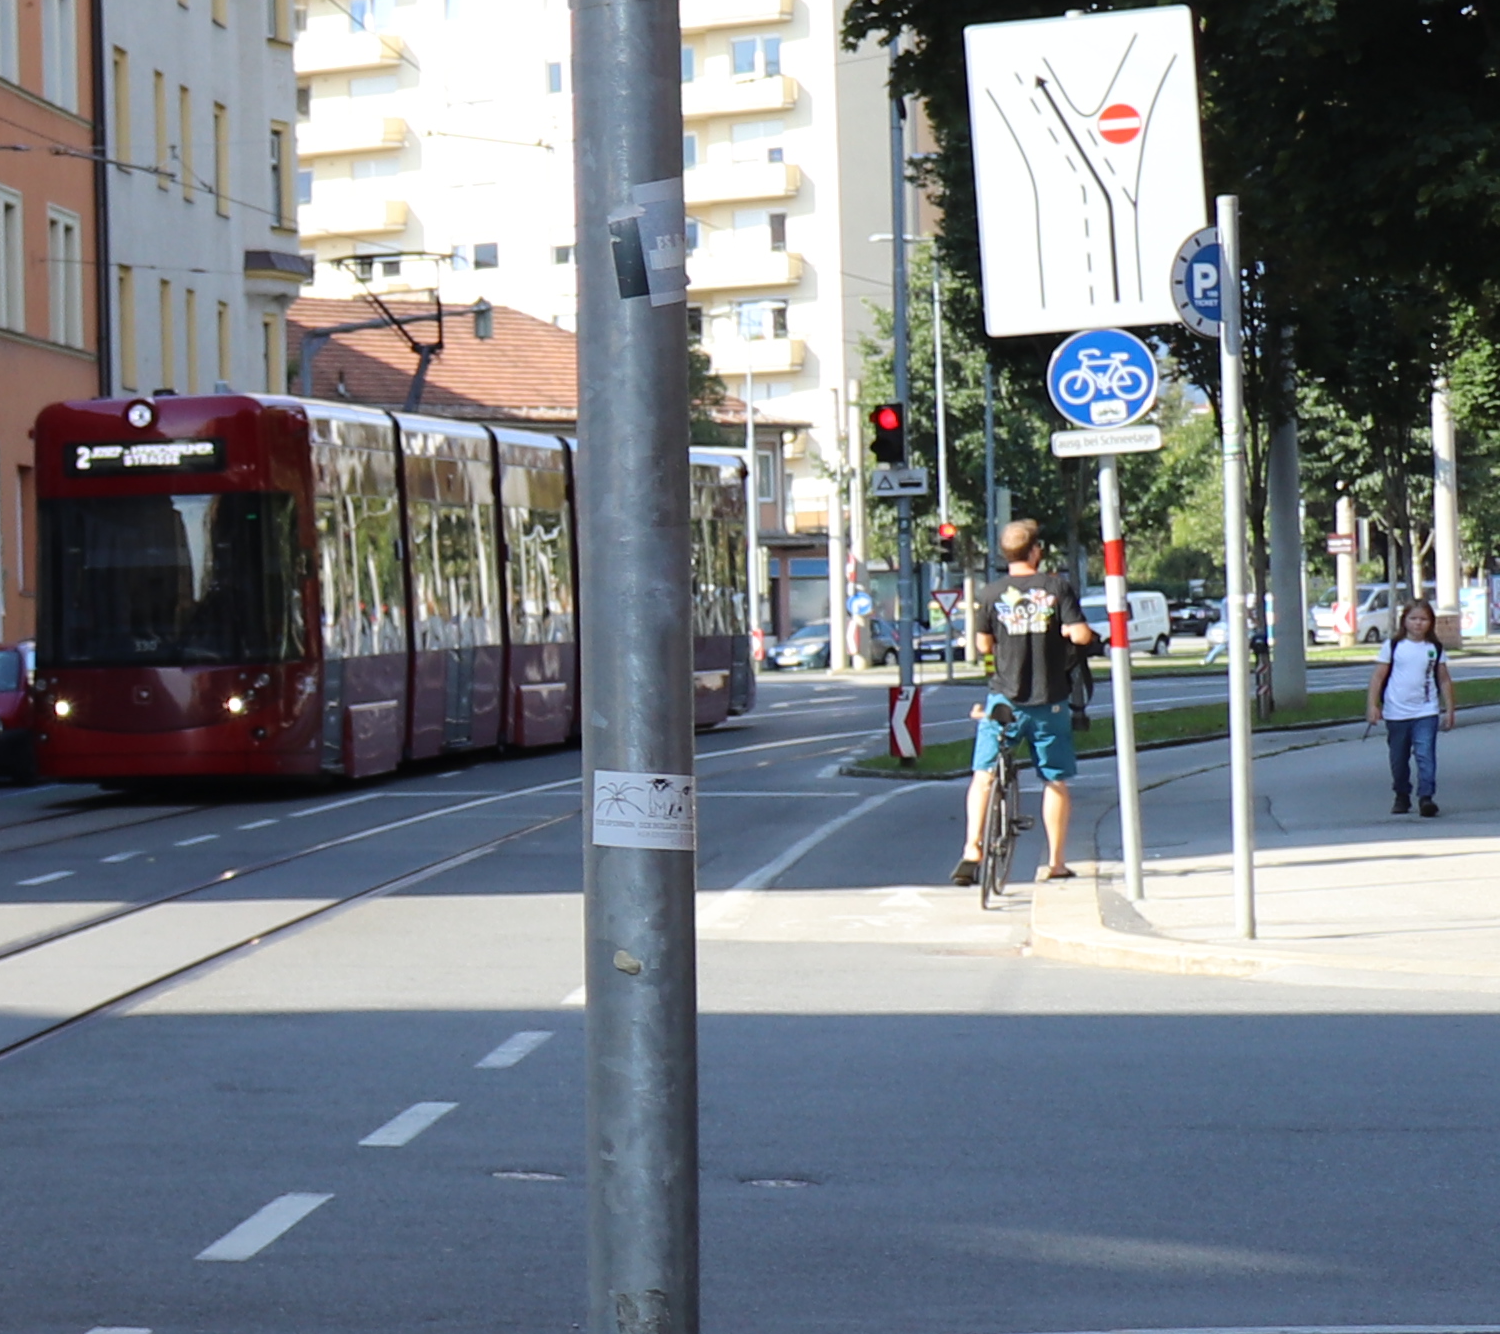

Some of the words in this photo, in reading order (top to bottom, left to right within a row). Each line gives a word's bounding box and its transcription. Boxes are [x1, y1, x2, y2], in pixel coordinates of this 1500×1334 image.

[1192, 262, 1218, 298] P
[1100, 432, 1154, 446] Schneelage
[76, 445, 92, 471] 2
